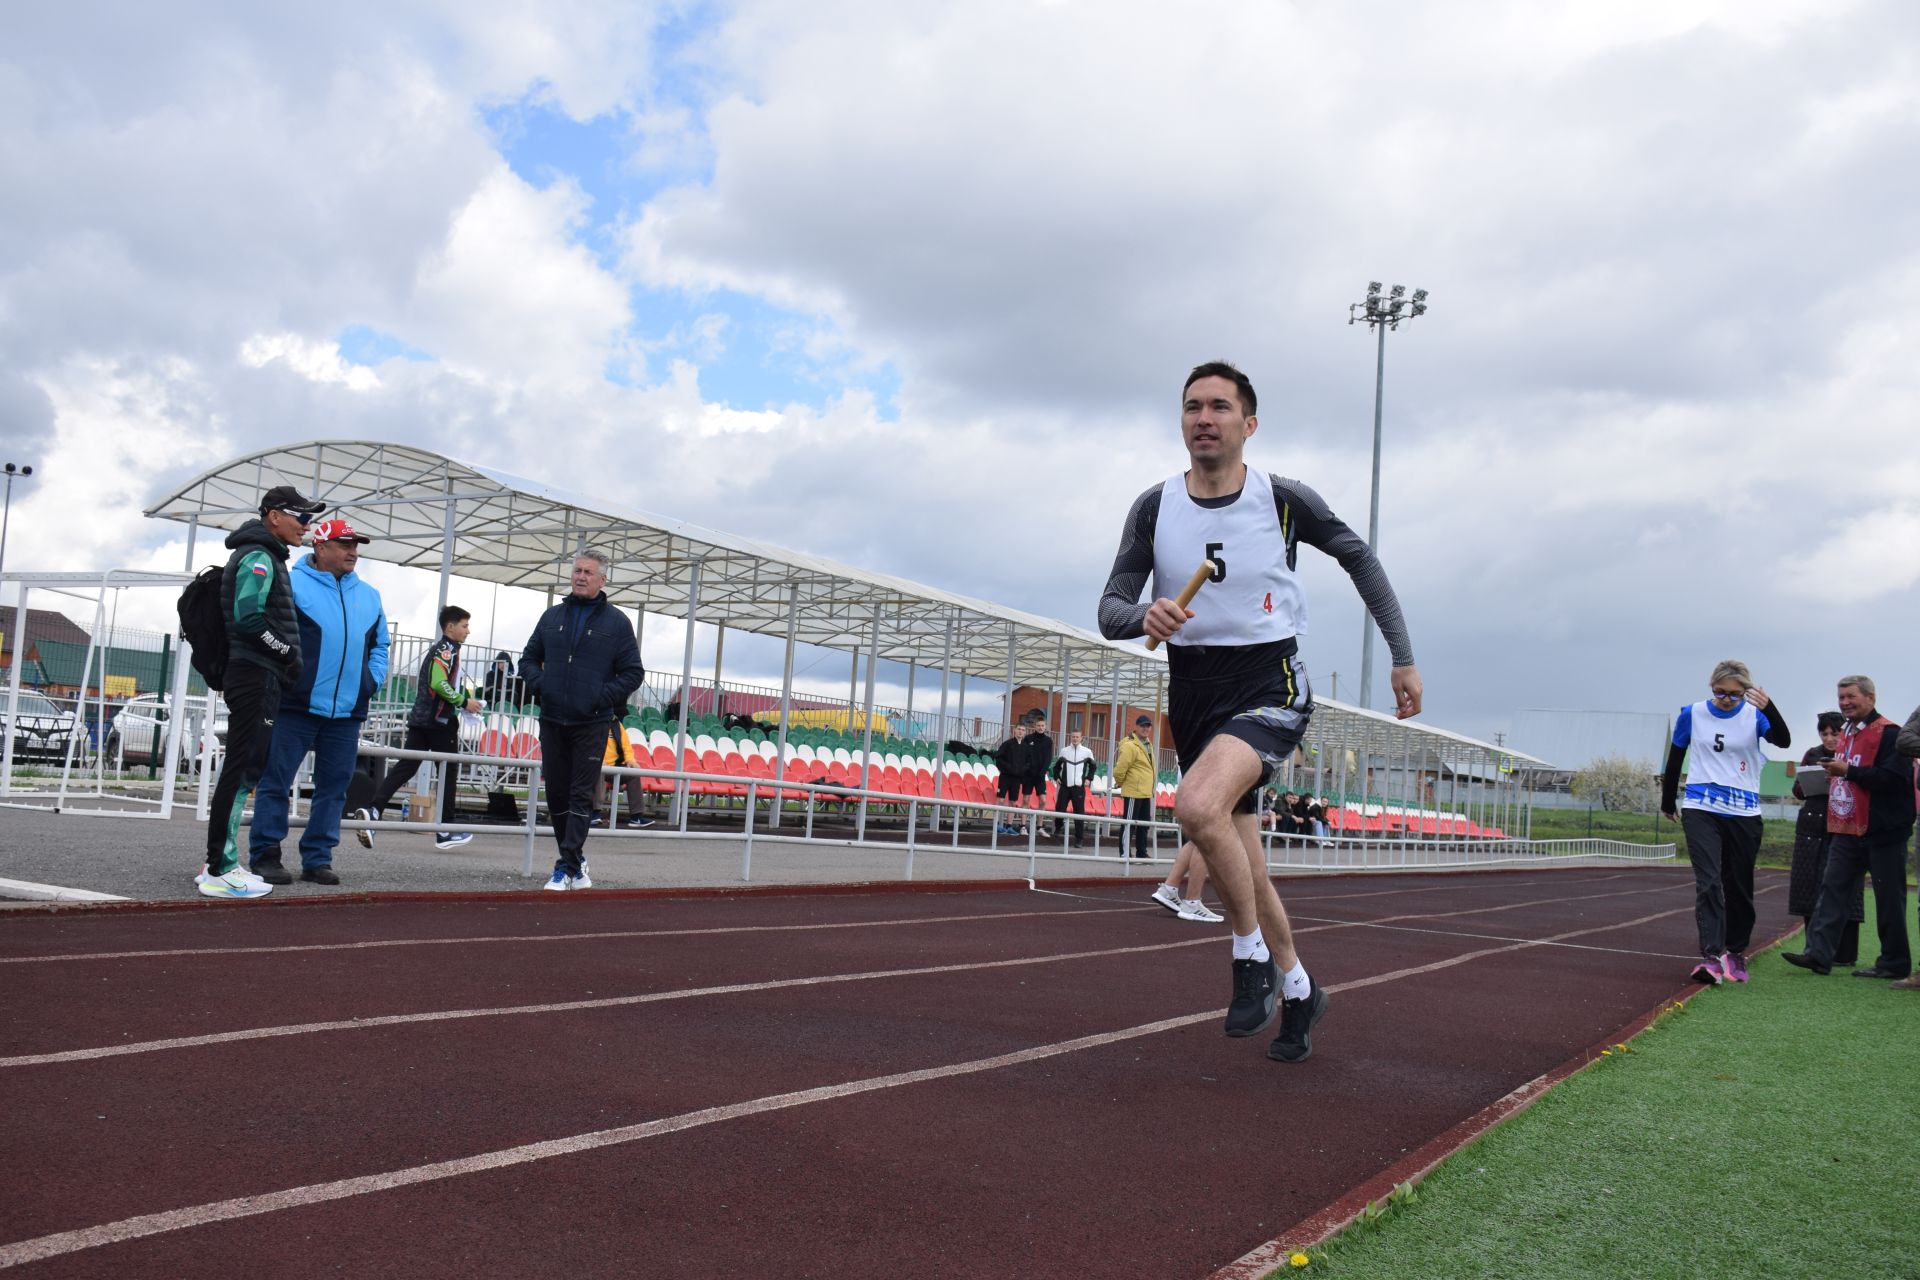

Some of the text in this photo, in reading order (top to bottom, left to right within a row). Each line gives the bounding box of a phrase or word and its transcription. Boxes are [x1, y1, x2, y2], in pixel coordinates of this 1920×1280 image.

[1206, 543, 1227, 583] 5
[1263, 592, 1272, 613] 4
[1713, 733, 1725, 752] 5
[1740, 760, 1746, 772] 3
